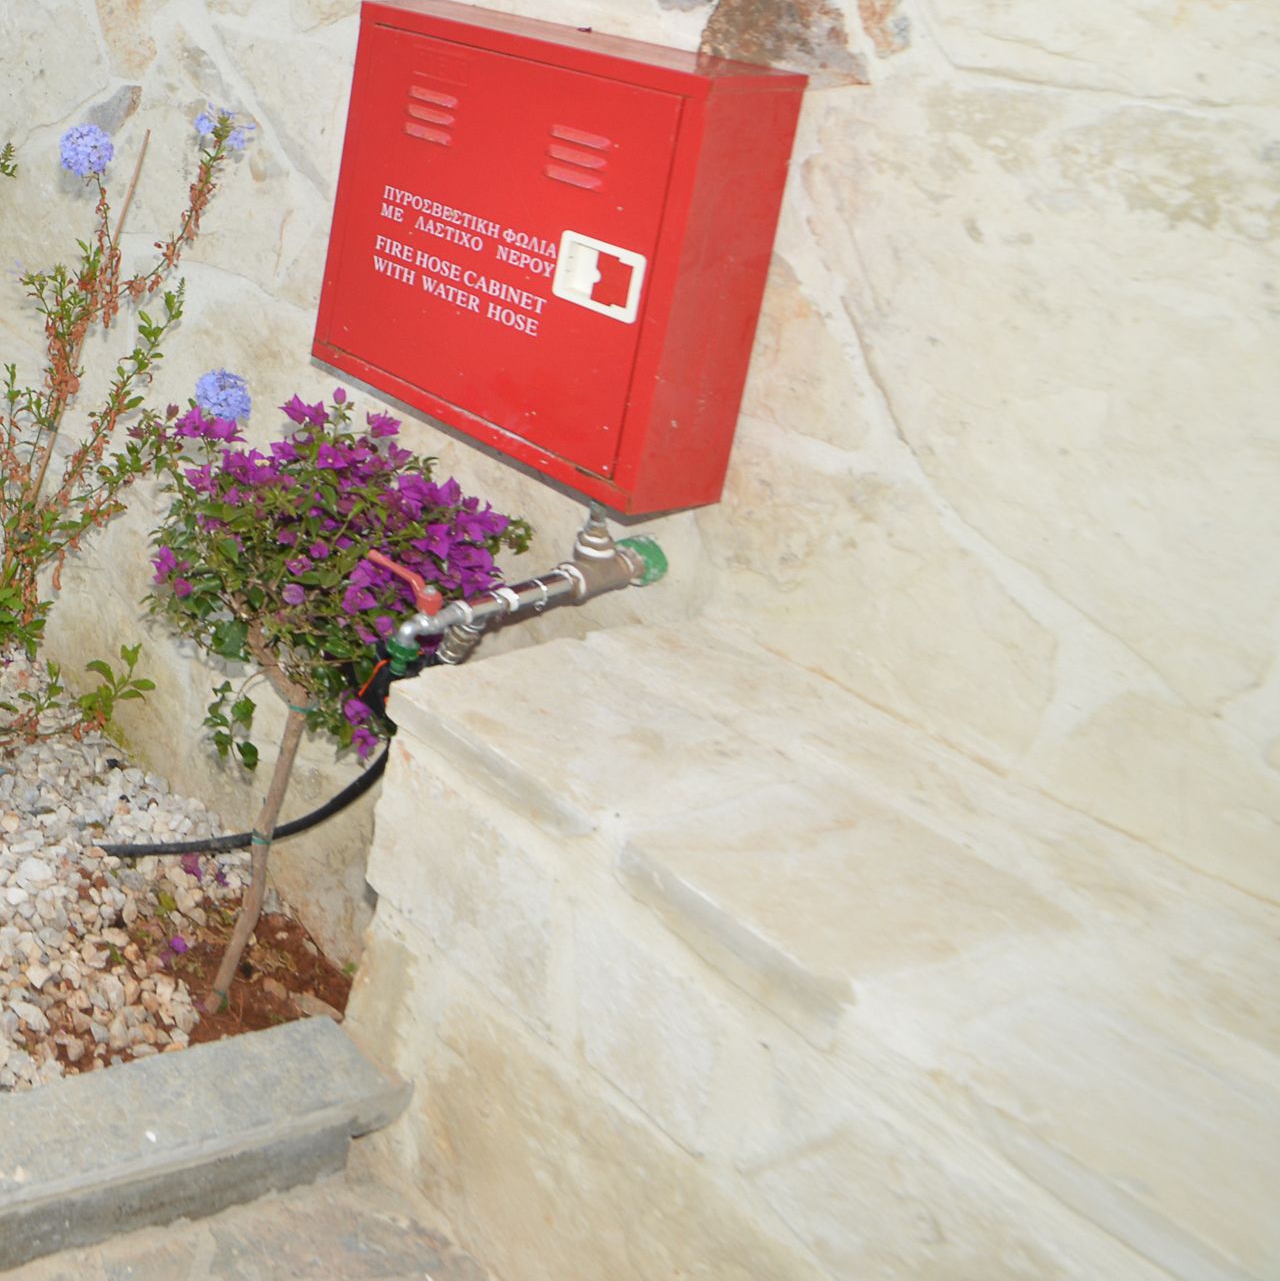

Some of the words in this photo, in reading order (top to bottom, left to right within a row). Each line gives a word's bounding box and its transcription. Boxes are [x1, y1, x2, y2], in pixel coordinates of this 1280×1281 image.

[380, 203, 404, 223] ΜΕ
[414, 216, 483, 251] ΛΑΣΤΙΧΟ
[496, 245, 556, 278] ΝΕΡΟΥ
[383, 185, 501, 238] ΠΥΡΟΣΒΕΣΤΙΚΗ
[502, 228, 557, 259] ΦΩΛΙΑ
[373, 255, 416, 286] WITH
[421, 275, 480, 312] WATER
[487, 302, 539, 337] HOSE
[375, 235, 414, 262] FIRE
[415, 250, 462, 282] HOSE
[463, 270, 547, 314] CABINET
